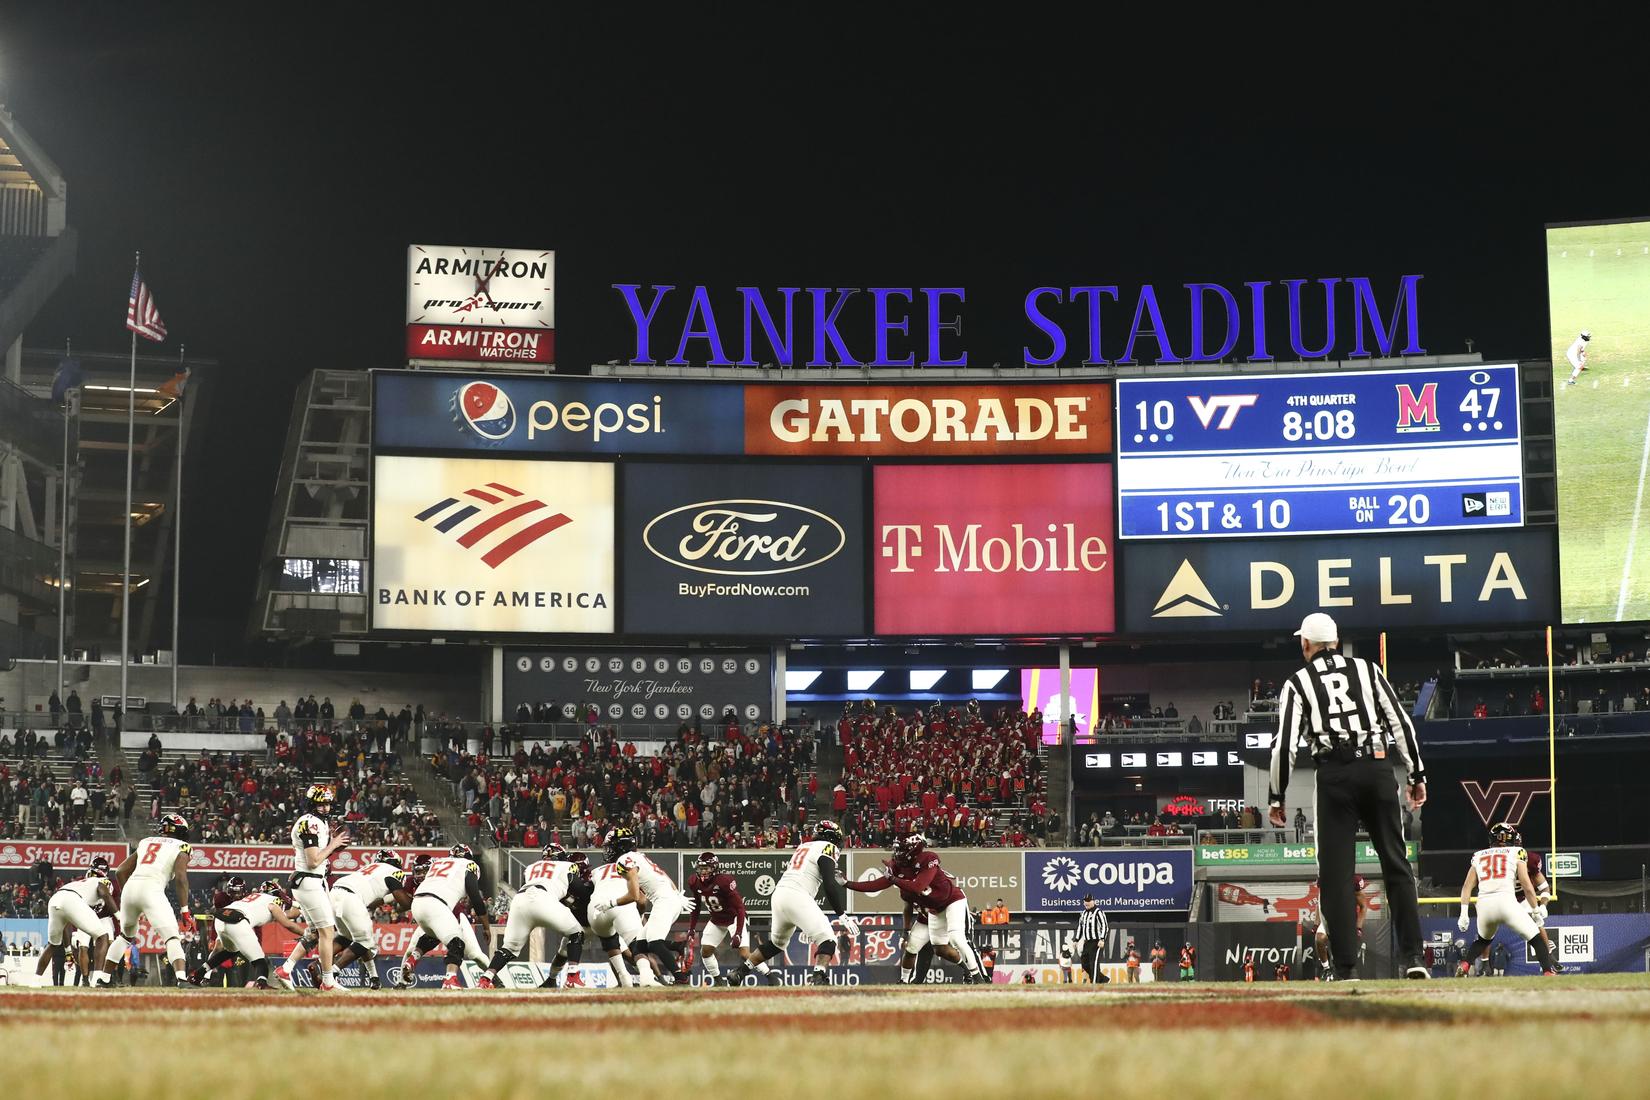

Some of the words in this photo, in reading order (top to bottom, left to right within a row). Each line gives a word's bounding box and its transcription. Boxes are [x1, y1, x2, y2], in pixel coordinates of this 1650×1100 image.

[416, 257, 547, 279] ARMITRON
[612, 284, 967, 367] YANKEE
[1023, 274, 1427, 366] STADIUM
[421, 329, 539, 349] ARMITRON
[479, 347, 537, 359] WATCHES
[1286, 394, 1308, 407] 4TH
[1308, 393, 1356, 406] QUARTER
[1459, 388, 1501, 420] 47
[528, 395, 662, 442] pepsi
[770, 397, 1087, 443] GATORADE
[1135, 400, 1175, 432] 10
[1187, 393, 1259, 430] VT
[1282, 410, 1356, 442] 8:08
[1349, 496, 1380, 510] BALL
[1388, 494, 1430, 525] 20
[1157, 501, 1214, 532] 1ST
[1221, 503, 1242, 529] &
[1251, 499, 1290, 530] 10
[1355, 510, 1374, 523] ON
[678, 509, 809, 562] Ford
[933, 523, 1108, 573] Mobile
[678, 582, 810, 599] BuyFordNow.com
[1250, 551, 1528, 610] DELTA
[378, 588, 447, 607] BANK
[455, 590, 486, 607] OF
[493, 590, 608, 609] AMERICA
[584, 678, 612, 693] New
[613, 678, 642, 700] York
[645, 679, 694, 700] Yankees
[1320, 672, 1357, 714] R
[1461, 777, 1557, 828] VT
[141, 842, 163, 864] 8
[1201, 847, 1249, 860] bet365
[1283, 847, 1316, 858] bet3
[744, 860, 772, 869] Circle
[1479, 854, 1507, 880] 30
[955, 876, 1018, 888] HOTELS
[1083, 862, 1174, 893] coupa
[742, 896, 769, 906] atters
[1041, 897, 1081, 907] Business
[1114, 897, 1175, 908] Management
[1564, 934, 1589, 944] NEW
[1564, 944, 1589, 955] ERA
[923, 968, 944, 984] 99
